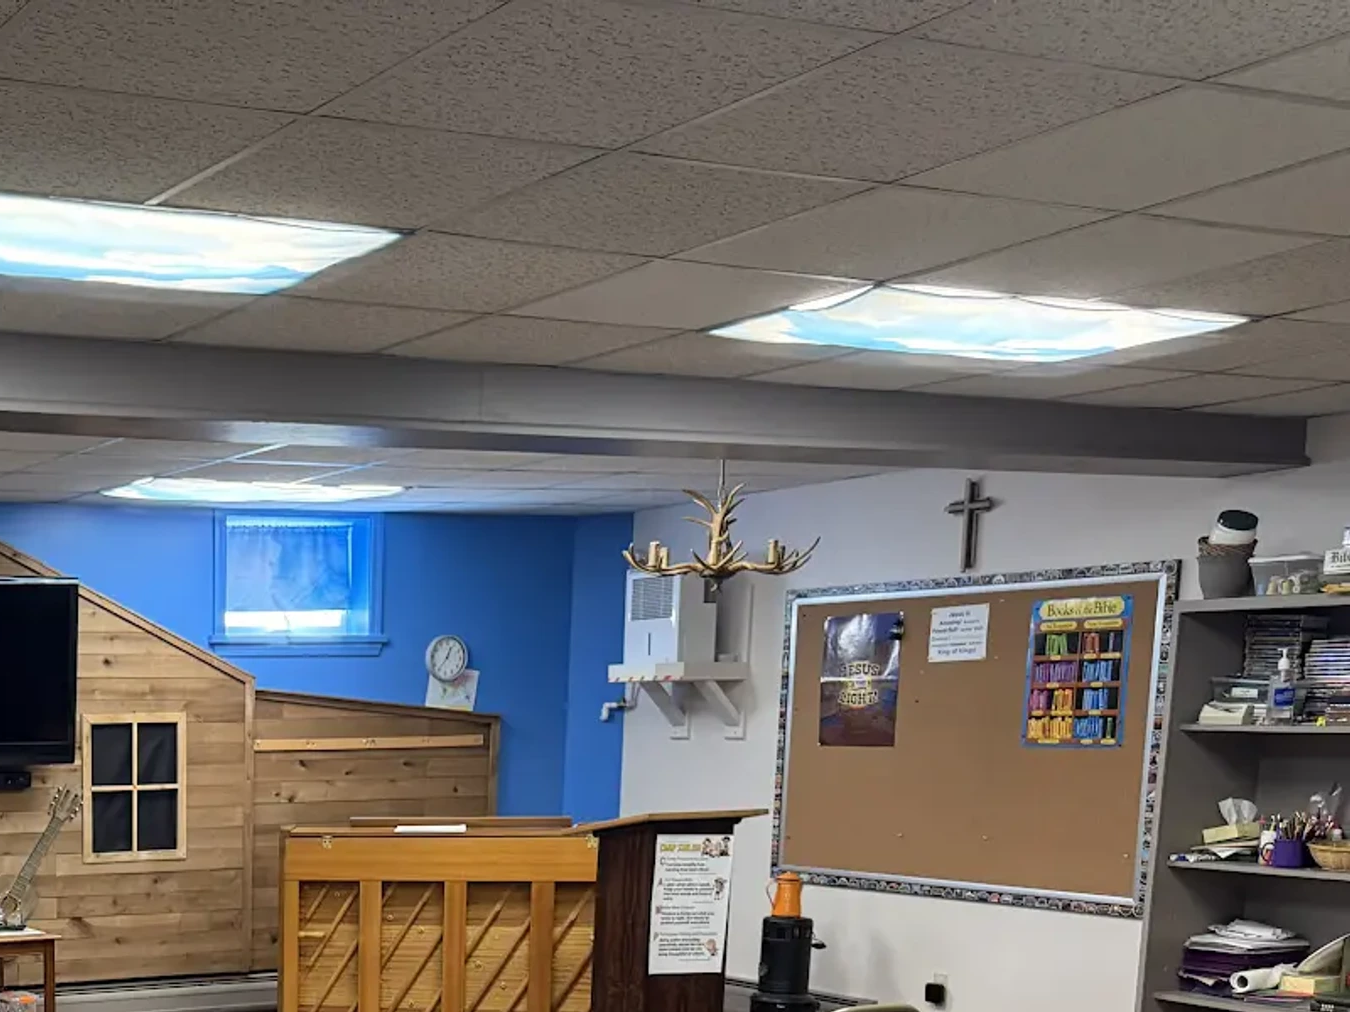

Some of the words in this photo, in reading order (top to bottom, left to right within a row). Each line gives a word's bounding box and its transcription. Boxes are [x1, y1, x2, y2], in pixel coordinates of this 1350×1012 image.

[1047, 602, 1074, 616] Books
[1093, 600, 1117, 614] Bible
[840, 661, 879, 677] JESUS
